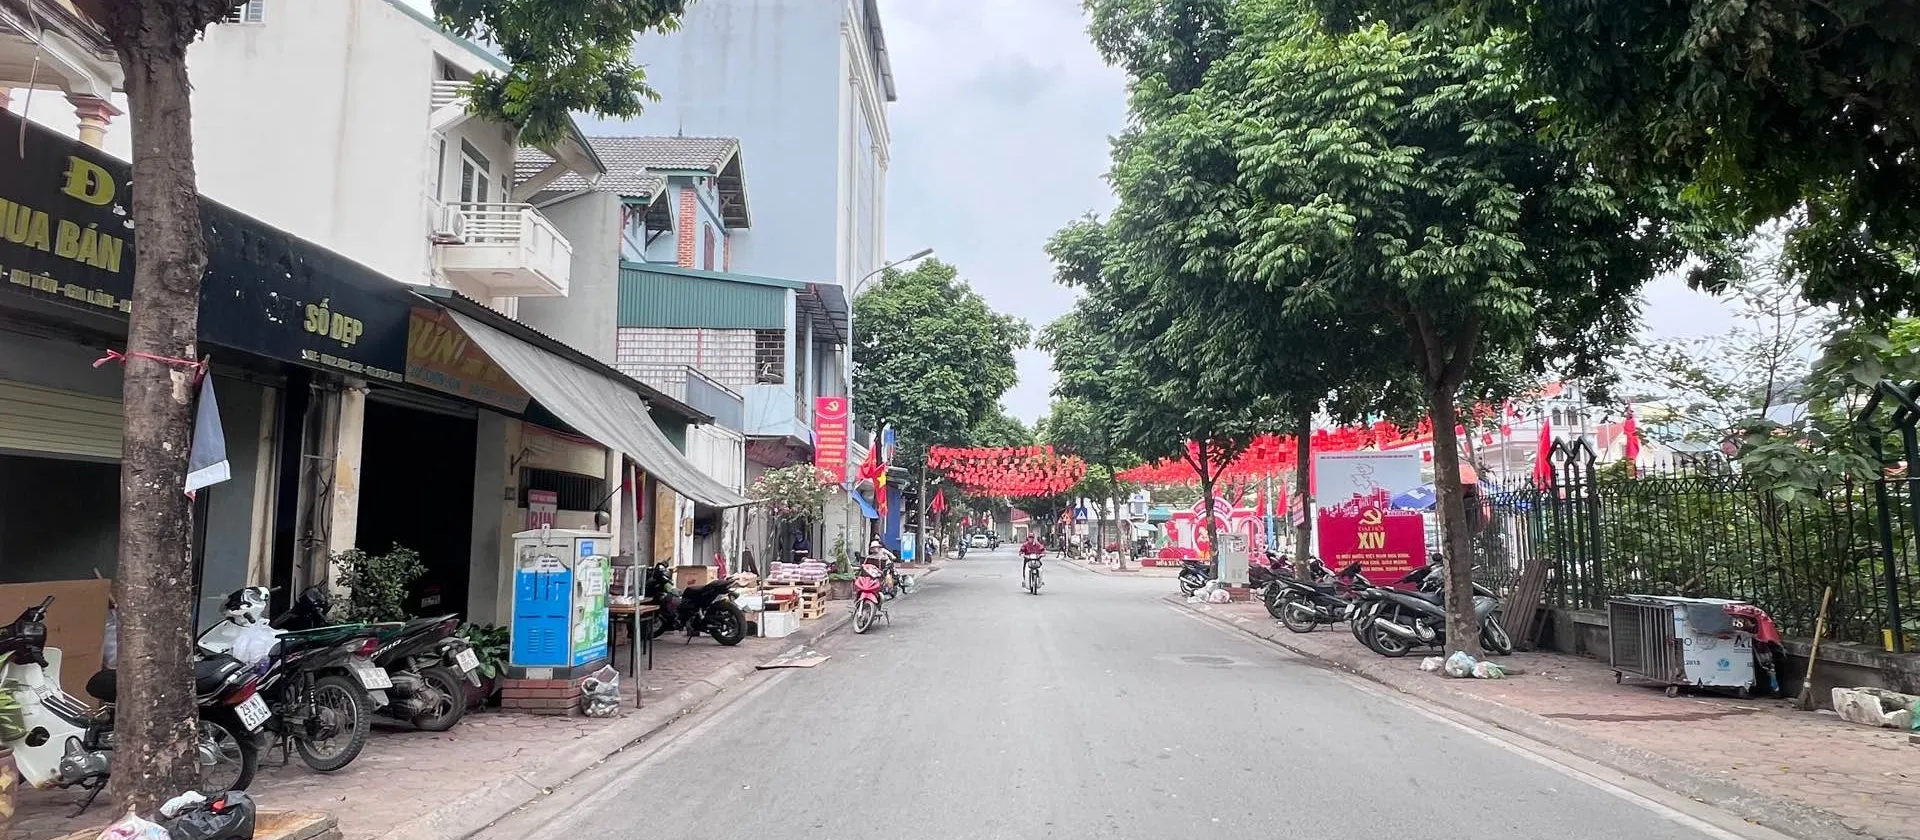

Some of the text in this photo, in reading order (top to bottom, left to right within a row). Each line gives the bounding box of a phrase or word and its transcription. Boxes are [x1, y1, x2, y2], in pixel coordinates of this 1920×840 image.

[55, 219, 123, 273] BÁN
[303, 298, 363, 348] SỐ ĐẸP
[1357, 532, 1385, 549] XIV
